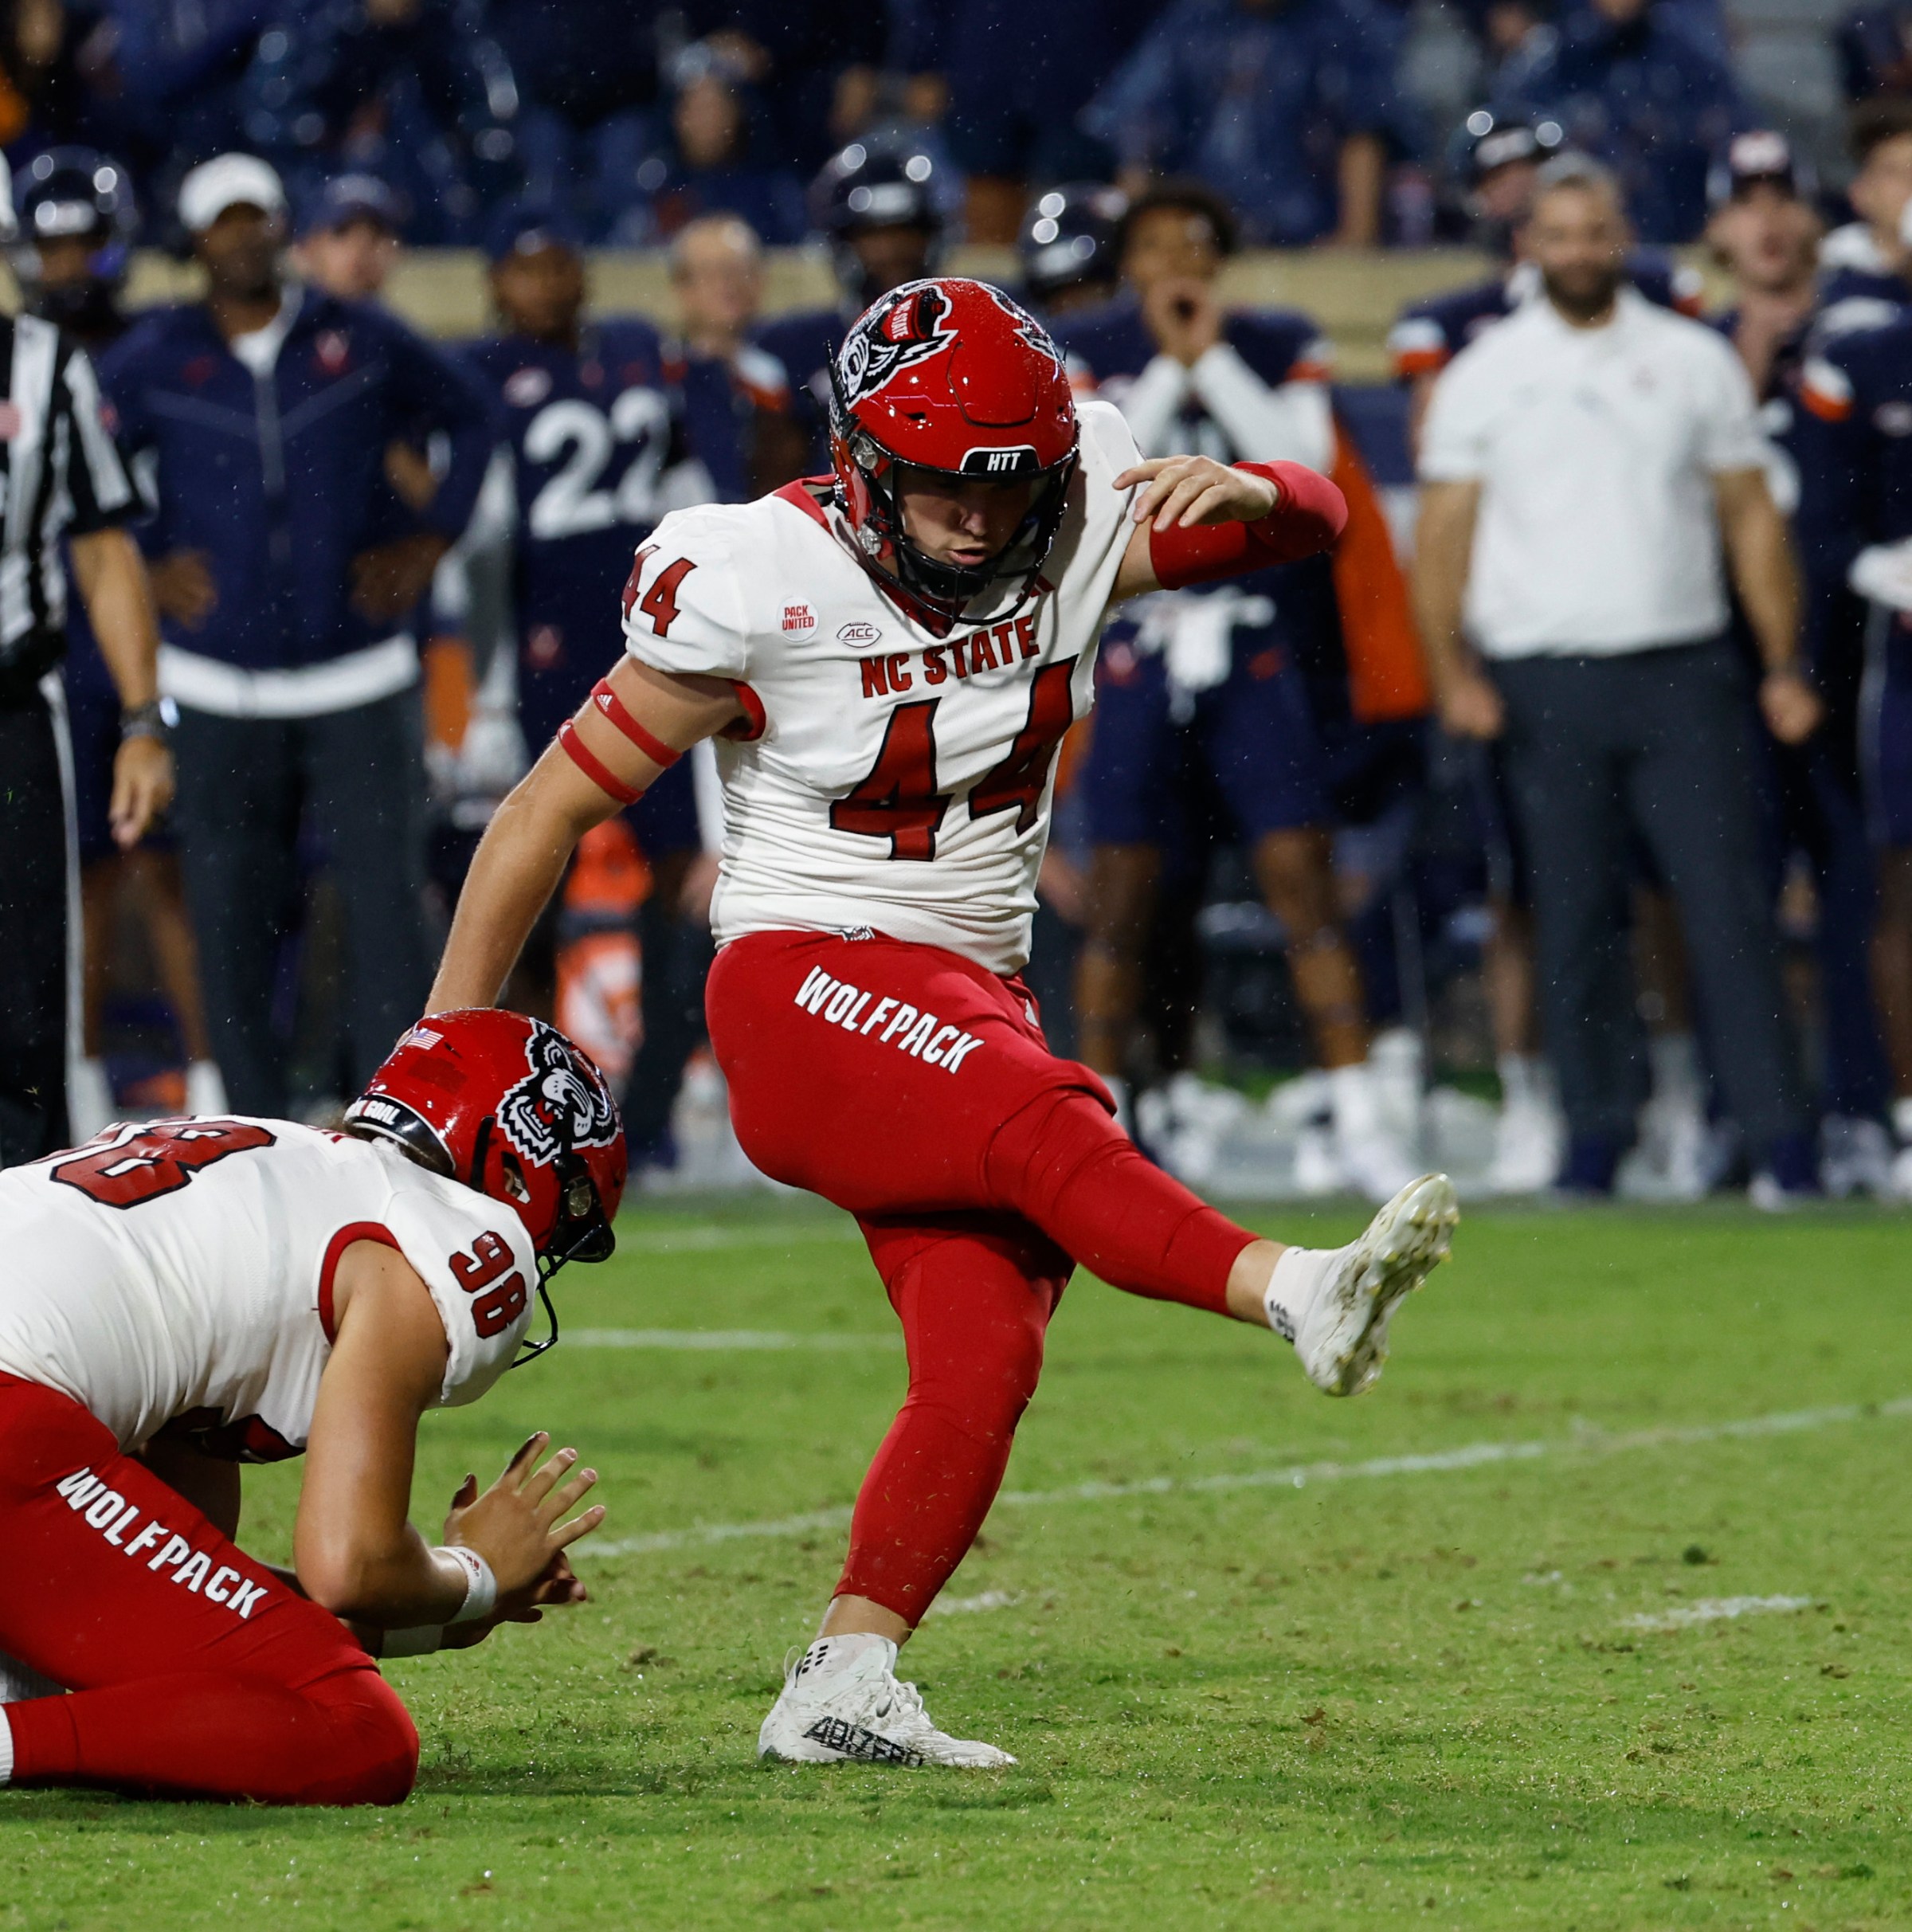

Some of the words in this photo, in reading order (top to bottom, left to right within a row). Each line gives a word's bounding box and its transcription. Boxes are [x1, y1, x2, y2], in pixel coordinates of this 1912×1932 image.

[891, 312, 909, 340] STATE
[894, 298, 913, 315] NC
[523, 386, 671, 540] 22
[987, 452, 1021, 472] HTT
[621, 543, 699, 638] 44
[782, 616, 815, 631] UNITED
[784, 605, 809, 619] PACK
[843, 627, 874, 639] ACC
[859, 652, 913, 699] NC
[922, 613, 1040, 686] STATE
[829, 653, 1079, 862] 44
[793, 964, 986, 1076] WOLFPACK
[449, 1230, 527, 1339] 98
[55, 1466, 269, 1620] WOLFPACK
